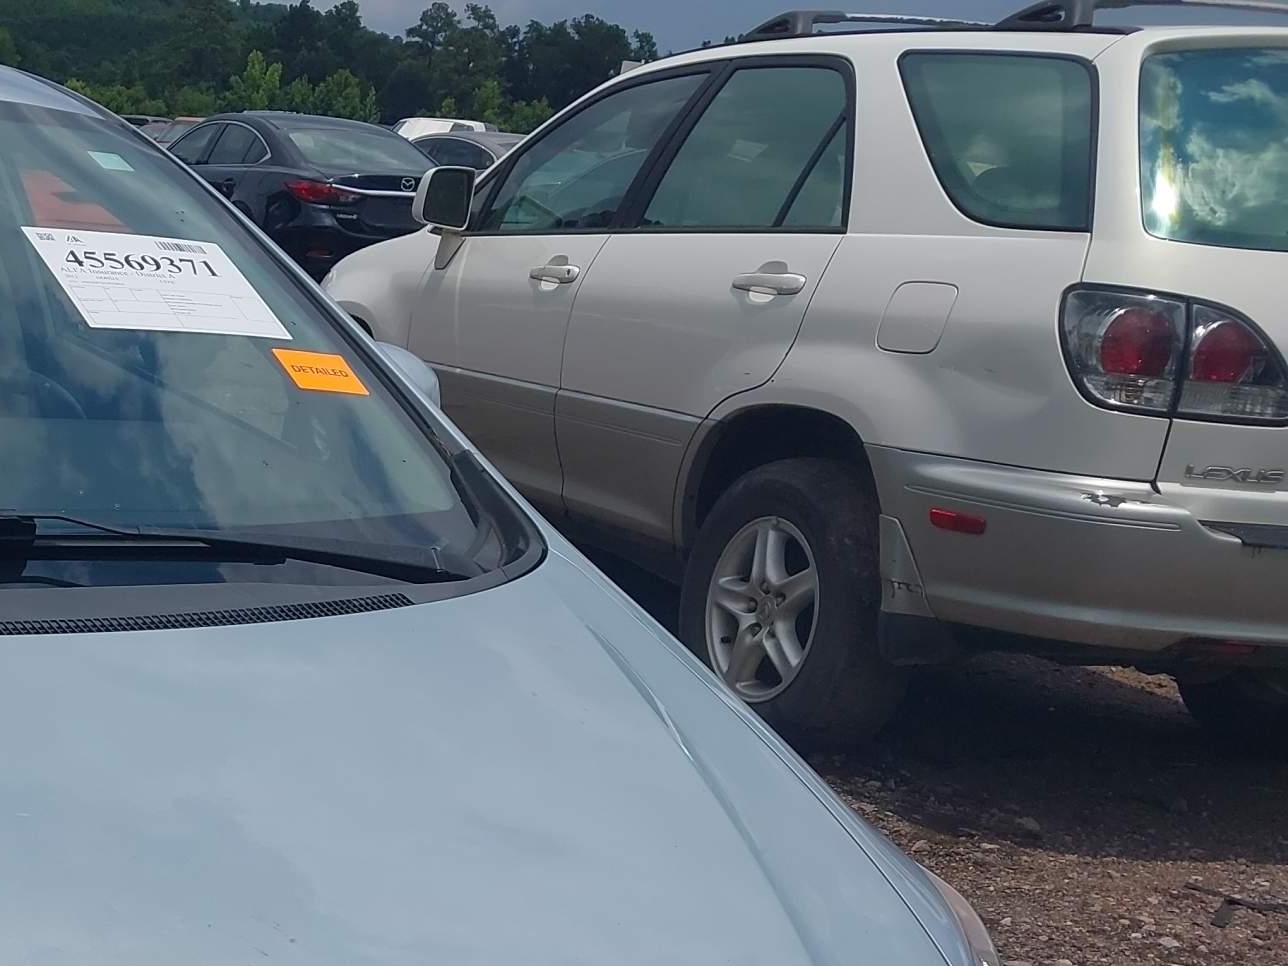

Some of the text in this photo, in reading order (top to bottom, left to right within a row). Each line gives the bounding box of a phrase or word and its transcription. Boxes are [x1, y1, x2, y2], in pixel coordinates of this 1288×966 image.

[65, 250, 222, 278] 45569371
[291, 365, 349, 378] DETAILED
[1184, 464, 1285, 484] LEXUS
